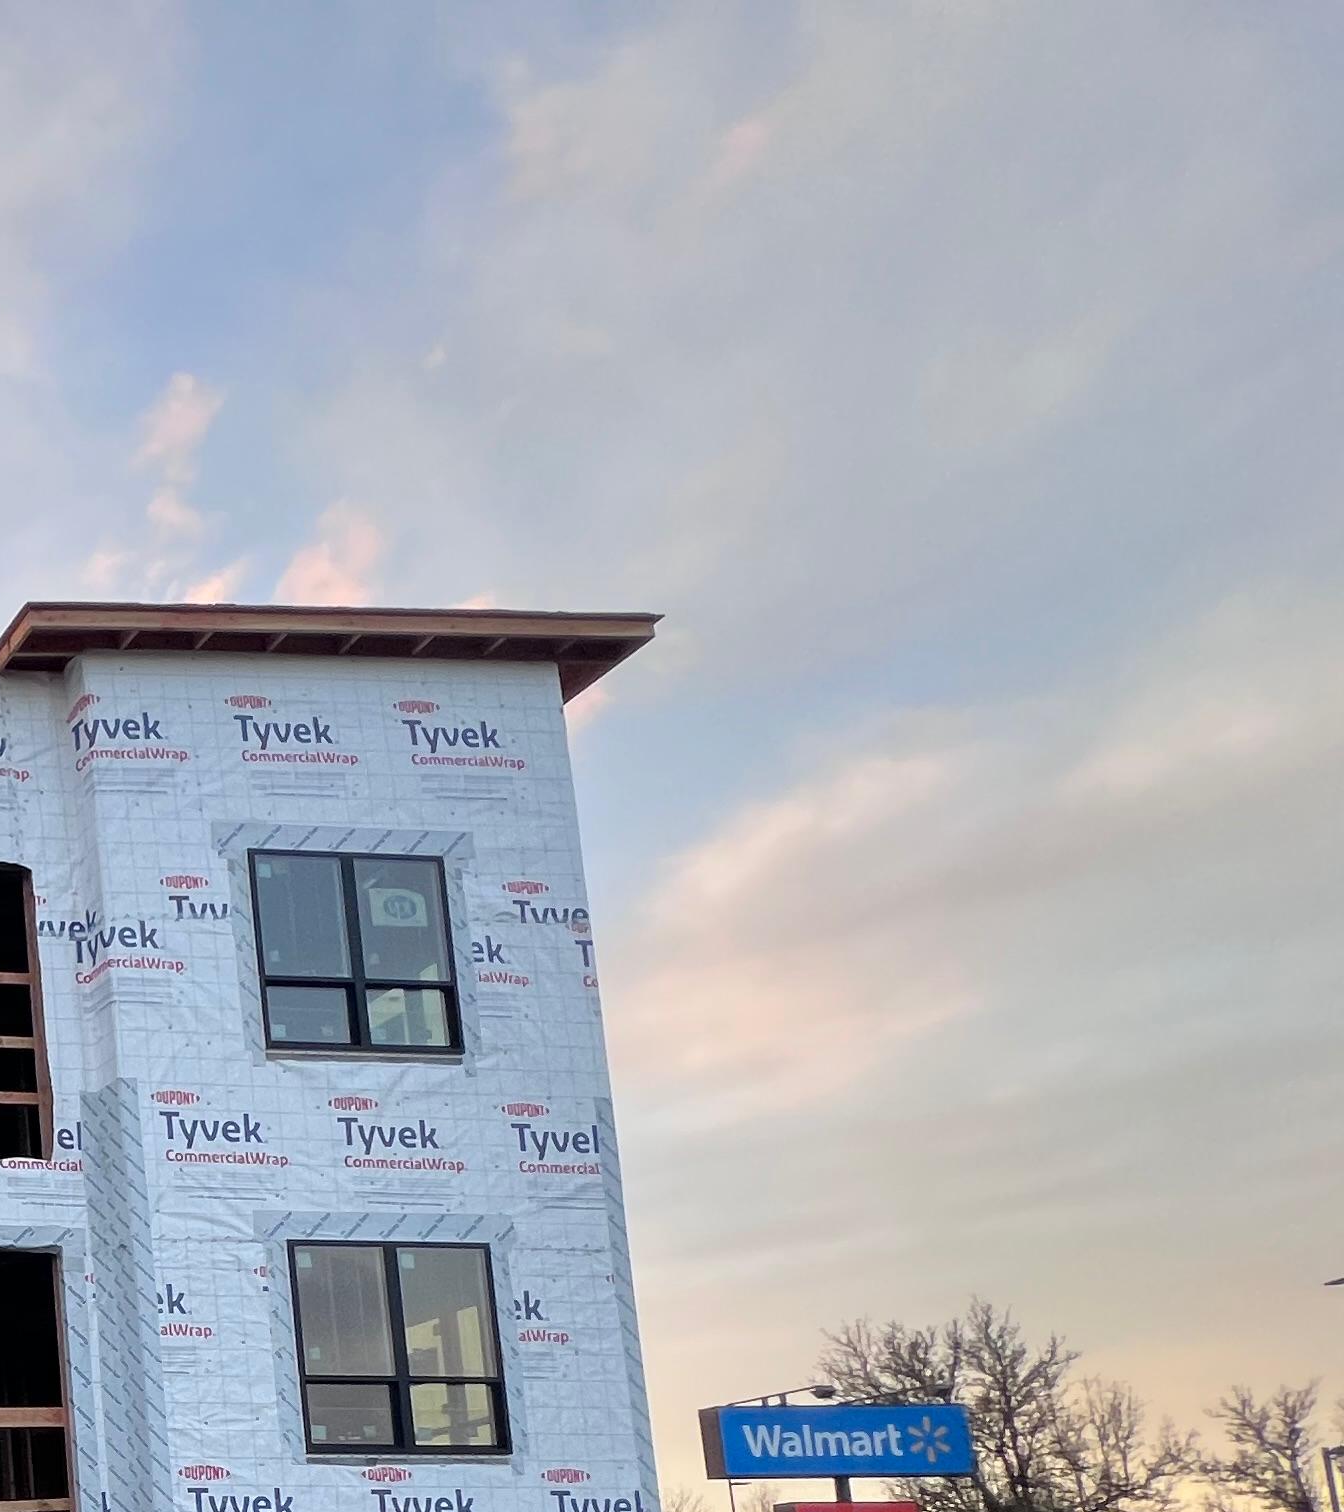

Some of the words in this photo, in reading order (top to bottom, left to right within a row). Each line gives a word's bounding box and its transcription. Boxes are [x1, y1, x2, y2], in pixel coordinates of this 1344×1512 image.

[235, 715, 333, 750] Tyvek
[402, 720, 500, 753] Tyvek
[160, 1111, 263, 1149] Tyvek
[337, 1118, 439, 1155] Tyvek
[743, 1424, 903, 1458] Walmart
